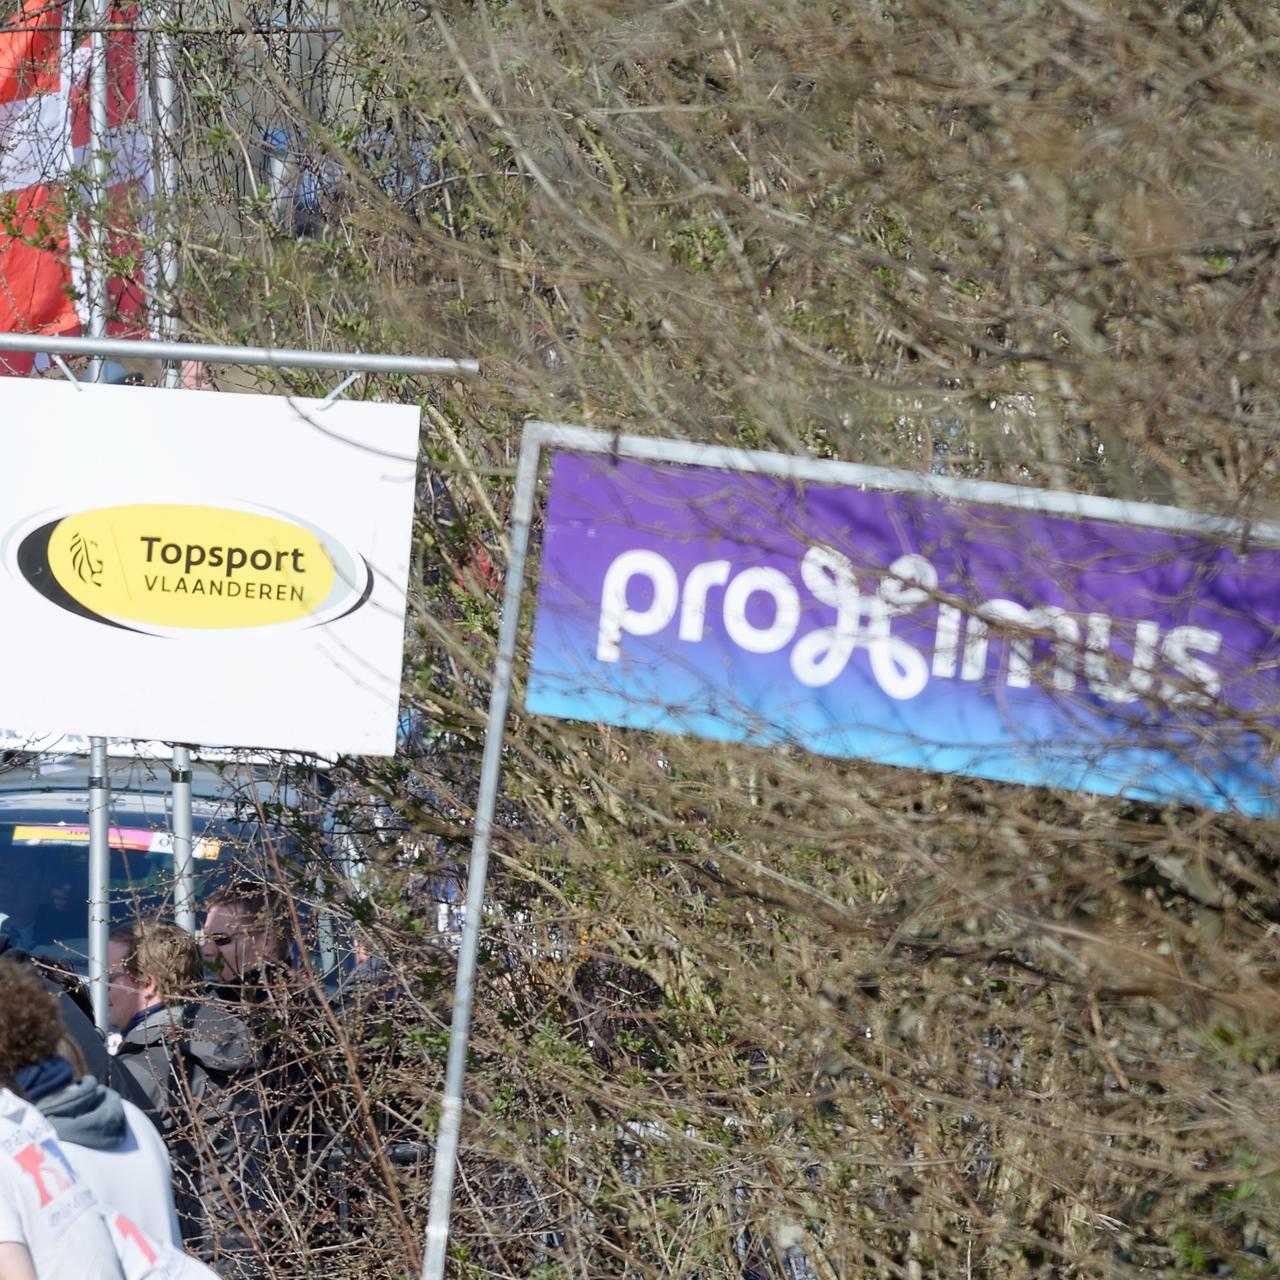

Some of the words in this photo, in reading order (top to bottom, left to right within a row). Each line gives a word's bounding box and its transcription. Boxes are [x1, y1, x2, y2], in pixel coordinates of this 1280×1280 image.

[140, 536, 306, 576] Topsport
[144, 574, 306, 602] VLAANDEREN
[596, 546, 1223, 701] proximus
